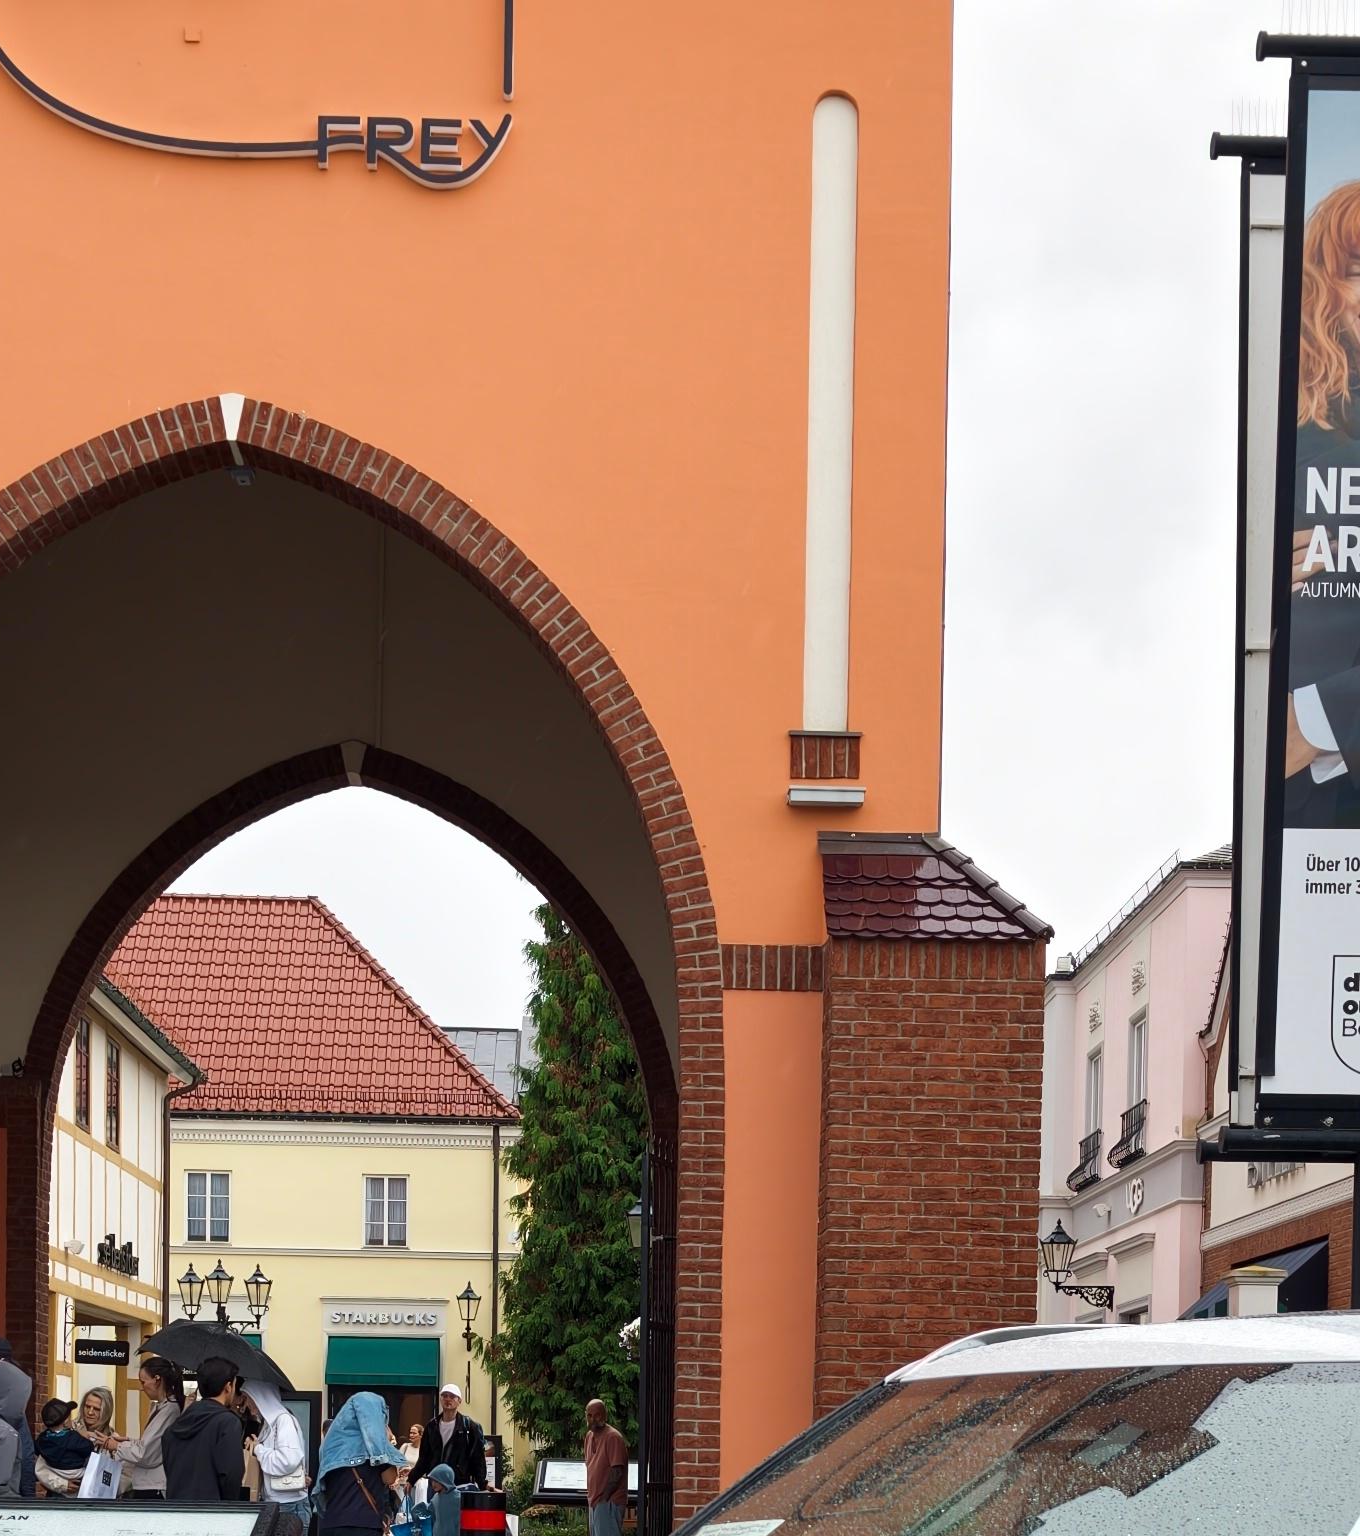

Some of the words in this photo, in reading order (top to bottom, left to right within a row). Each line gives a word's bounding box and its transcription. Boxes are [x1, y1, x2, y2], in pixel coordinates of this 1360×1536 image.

[318, 113, 513, 190] FREY
[1306, 853, 1340, 872] Über
[1305, 879, 1352, 894] immer
[330, 1311, 437, 1326] STARBUCKS
[78, 1348, 126, 1358] seidensticker
